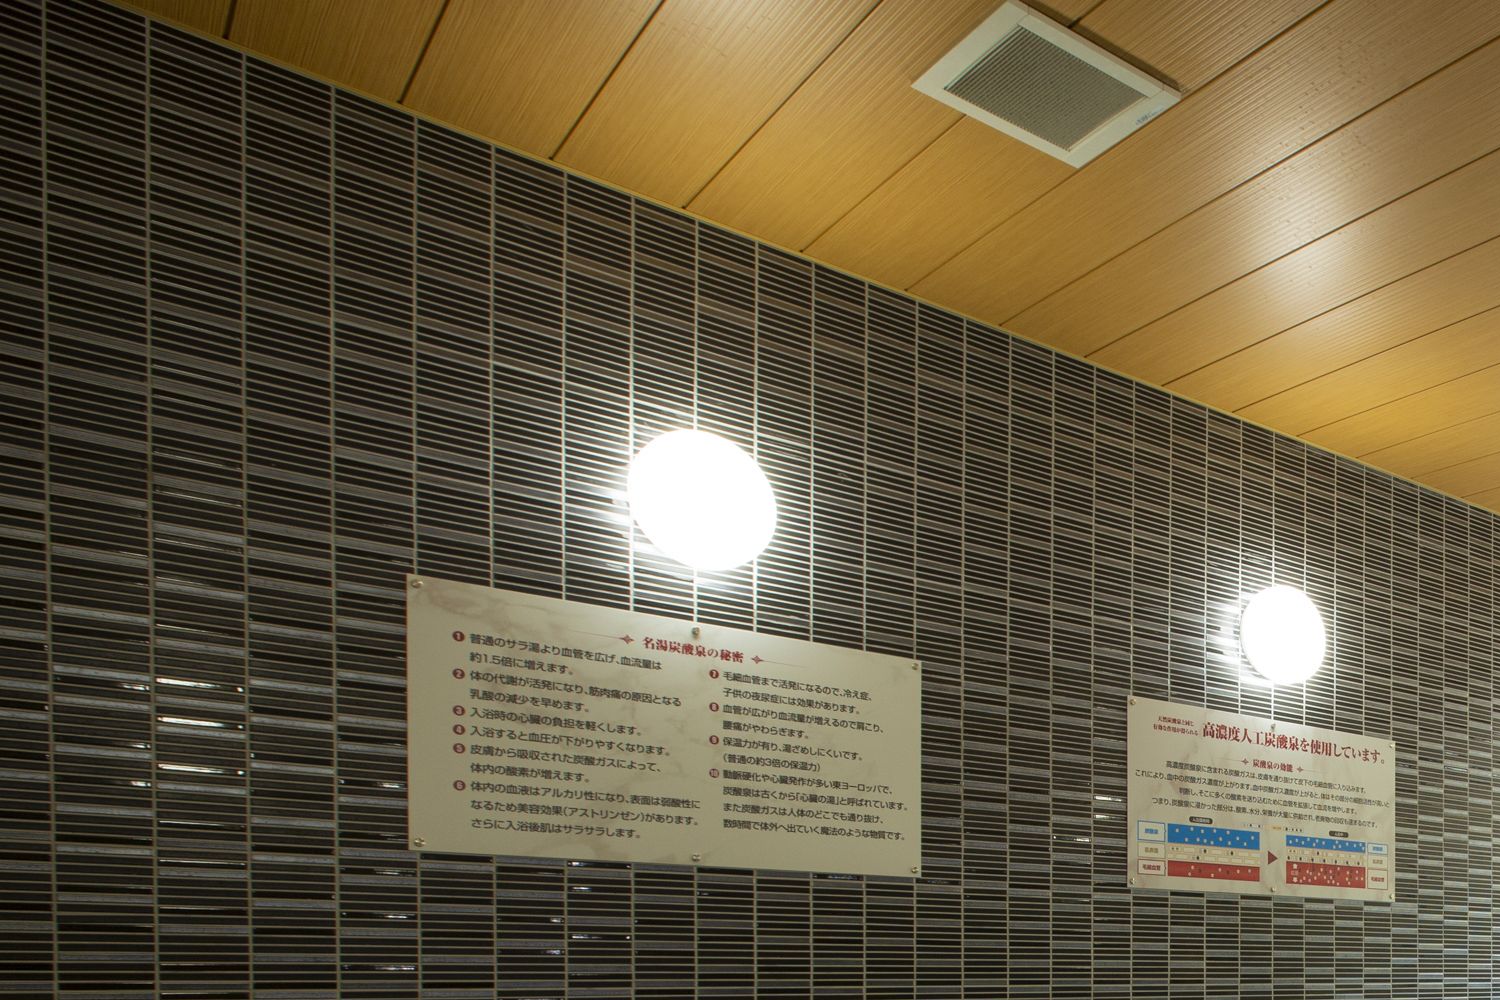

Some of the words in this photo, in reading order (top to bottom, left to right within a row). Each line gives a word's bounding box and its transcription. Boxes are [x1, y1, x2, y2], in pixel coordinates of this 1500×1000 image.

[469, 651, 574, 675] 約1.5倍に増えます。
[643, 637, 744, 664] 名湯炭酸泉の秘密
[469, 688, 589, 713] 乳酸の減少を早めます。
[470, 726, 670, 757] 入浴すると血圧が下がりやすくなります。
[1202, 722, 1385, 765] 高濃度人工炭酸泉を使用しています。
[470, 762, 590, 783] 体内の酸素が増えます。
[471, 819, 641, 839] さらに入浴後肌はサラサラします。
